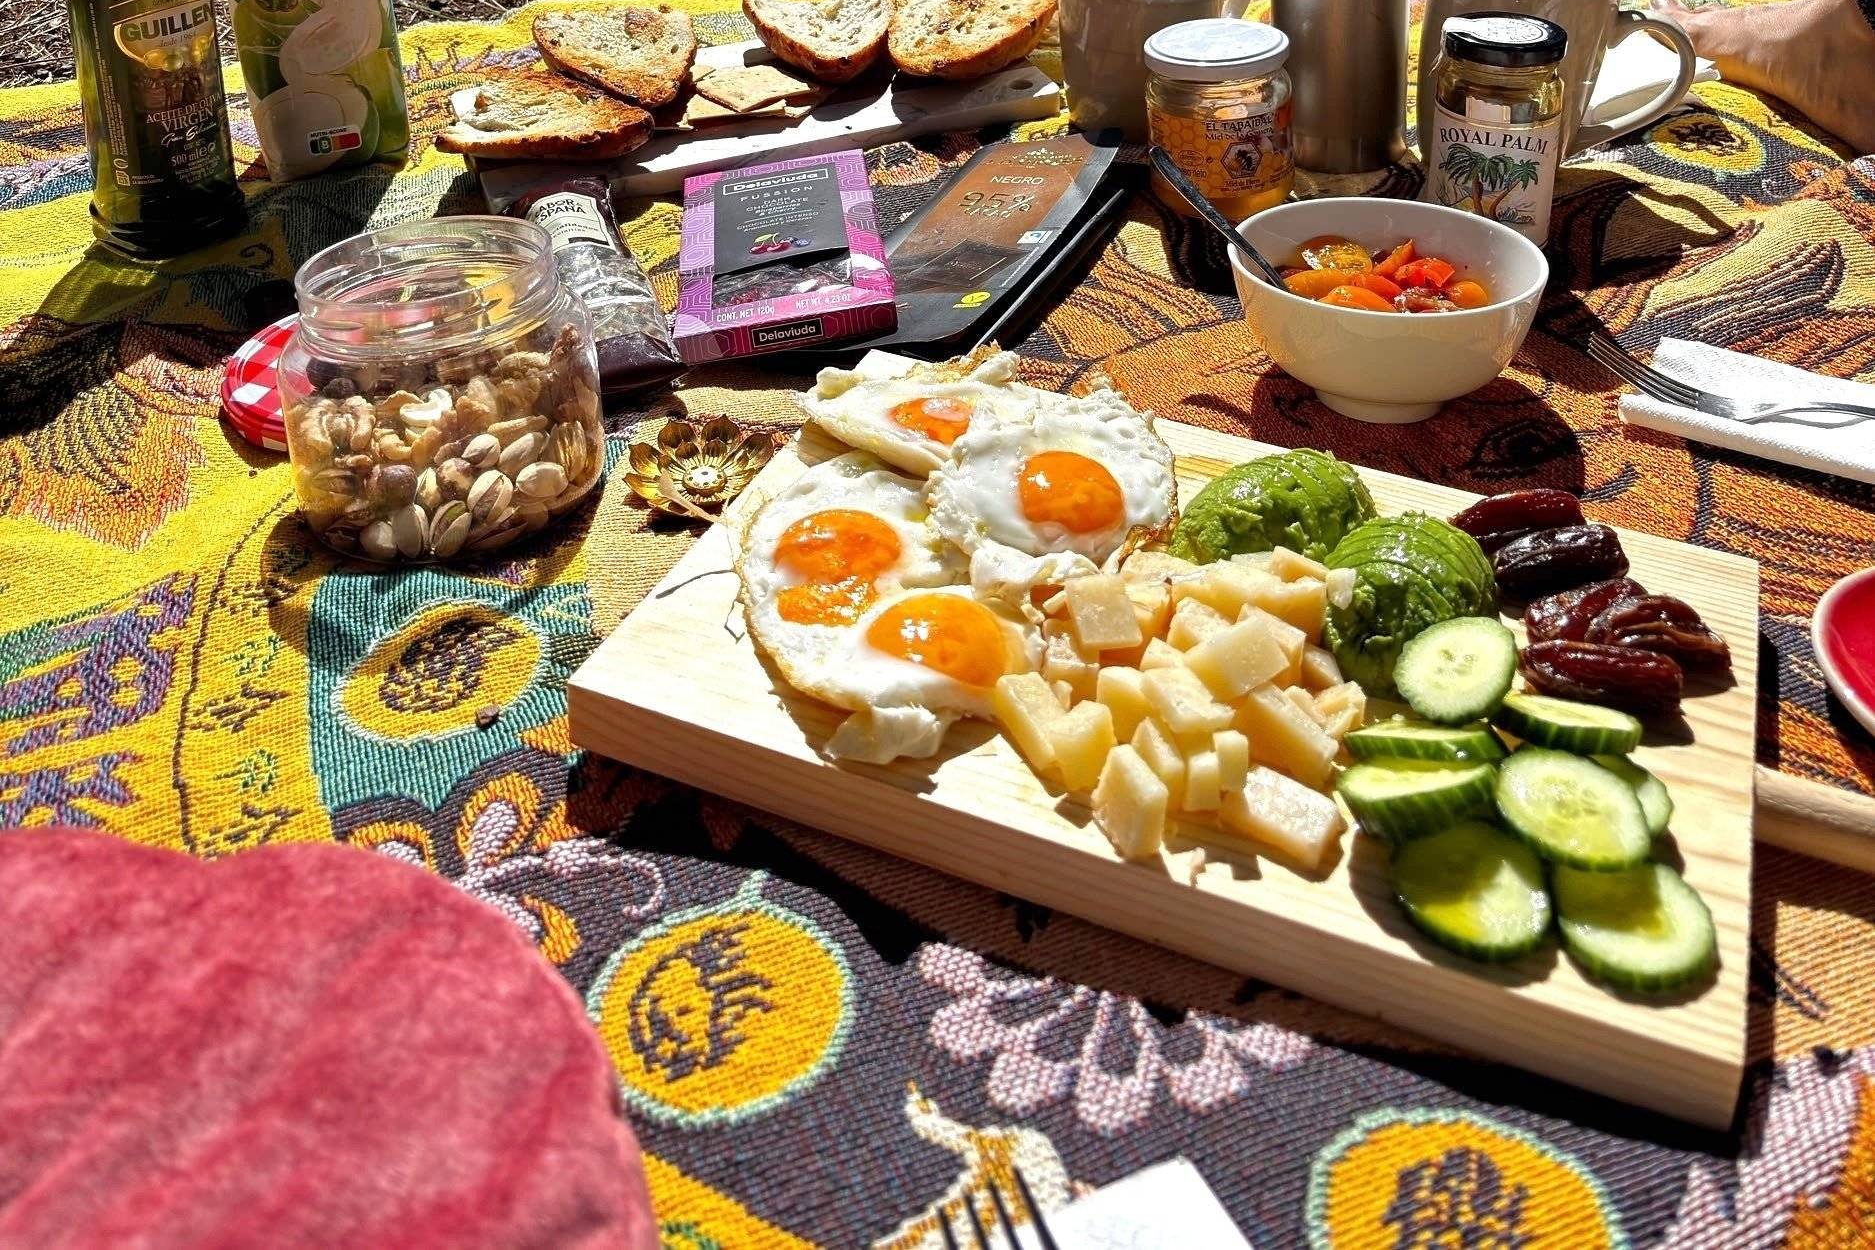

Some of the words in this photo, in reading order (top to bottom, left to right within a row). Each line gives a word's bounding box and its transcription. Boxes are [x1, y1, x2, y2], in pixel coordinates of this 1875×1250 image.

[146, 108, 184, 124] ACEITE
[185, 102, 199, 115] DE
[161, 107, 214, 132] VIRGEN
[321, 140, 329, 149] B
[1439, 127, 1496, 147] ROYAL
[1502, 133, 1549, 155] PALM
[171, 154, 187, 166] 500
[189, 148, 199, 161] ml
[733, 172, 818, 191] Delaviuda
[990, 175, 1045, 185] NEGRO
[741, 185, 813, 201] FUSSION
[764, 196, 791, 205] DARK
[959, 190, 1035, 212] 95%
[746, 197, 809, 212] CHOCOLATE
[716, 311, 739, 323] CONT.
[740, 308, 754, 319] NET
[757, 305, 775, 316] 120g
[759, 324, 816, 343] Delaviuda
